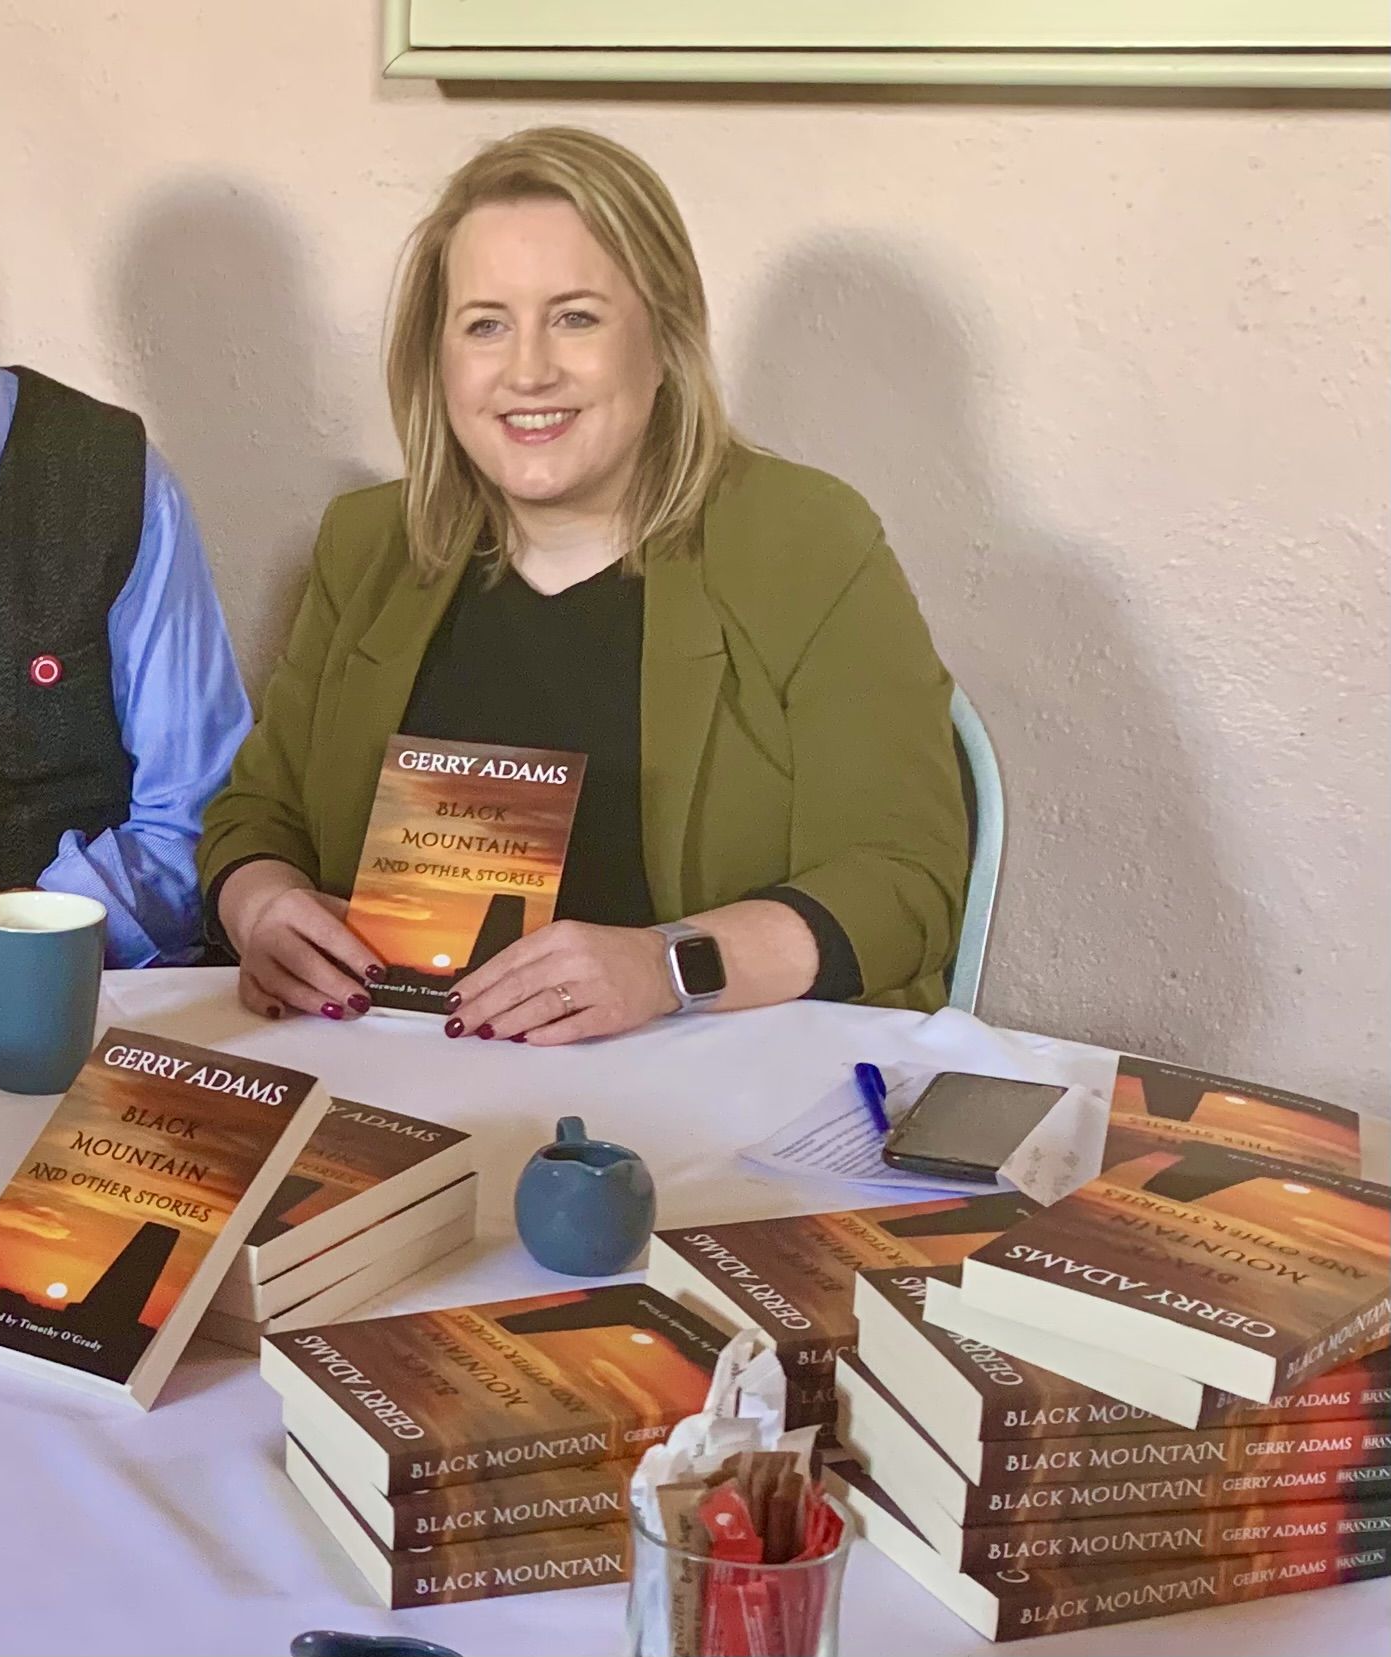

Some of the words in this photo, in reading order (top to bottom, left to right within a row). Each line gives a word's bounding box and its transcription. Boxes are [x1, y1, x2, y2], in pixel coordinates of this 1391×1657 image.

[398, 750, 477, 776] GERRY
[478, 759, 568, 785] ADAMS
[434, 800, 508, 822] BLACK
[400, 828, 529, 856] MOUNTAIN
[371, 856, 409, 873] AND
[415, 861, 475, 881] OTHER
[476, 868, 545, 887] STORIES
[104, 1045, 191, 1078] GERRY
[187, 1067, 288, 1106] ADAMS
[121, 1106, 200, 1140] BLACK
[341, 1112, 441, 1143] ADAMS
[69, 1131, 209, 1183] MOUNTAIN
[28, 1162, 68, 1183] AND
[71, 1172, 136, 1203] OTHER
[134, 1190, 212, 1223] STORIES
[1105, 1188, 1207, 1224] STORIES
[683, 1234, 760, 1279] ADAMS
[1110, 1214, 1311, 1285] MOUNTAIN
[1213, 1220, 1300, 1257] OTHER
[1005, 1245, 1148, 1293] ADAMS
[1308, 1255, 1368, 1280] AND
[739, 1284, 811, 1329] GERRY
[1143, 1291, 1276, 1338] GERRY
[6, 1314, 18, 1327] by
[19, 1318, 59, 1338] Timothy
[61, 1331, 103, 1353] O'Grady
[294, 1335, 372, 1384] ADAMS
[350, 1389, 424, 1439] GERRY
[1004, 1405, 1081, 1427] BLACK
[1295, 1392, 1351, 1407] ADAMS
[410, 1453, 479, 1479] BLACK
[485, 1432, 609, 1468] MOUNTAIN
[624, 1425, 668, 1443] GERRY
[1005, 1451, 1082, 1472] BLACK
[1089, 1441, 1227, 1468] MOUNTAIN
[1245, 1440, 1295, 1456] GERRY
[1297, 1437, 1353, 1453] ADAMS
[989, 1488, 1063, 1511] BLACK
[1071, 1478, 1207, 1506] MOUNTAIN
[1222, 1475, 1273, 1492] GERRY
[1274, 1471, 1327, 1487] ADAMS
[415, 1509, 485, 1534] BLACK
[493, 1492, 622, 1525] MOUNTAIN
[988, 1538, 1062, 1560] BLACK
[1070, 1528, 1205, 1556] MOUNTAIN
[1222, 1525, 1273, 1542] GERRY
[1274, 1522, 1327, 1537] ADAMS
[415, 1571, 487, 1594] BLACK
[493, 1554, 624, 1586] MOUNTAIN
[1020, 1600, 1088, 1625] BLACK
[1096, 1576, 1216, 1612] MOUNTAIN
[1233, 1568, 1275, 1587] GERRY
[1276, 1561, 1327, 1579] ADAMS
